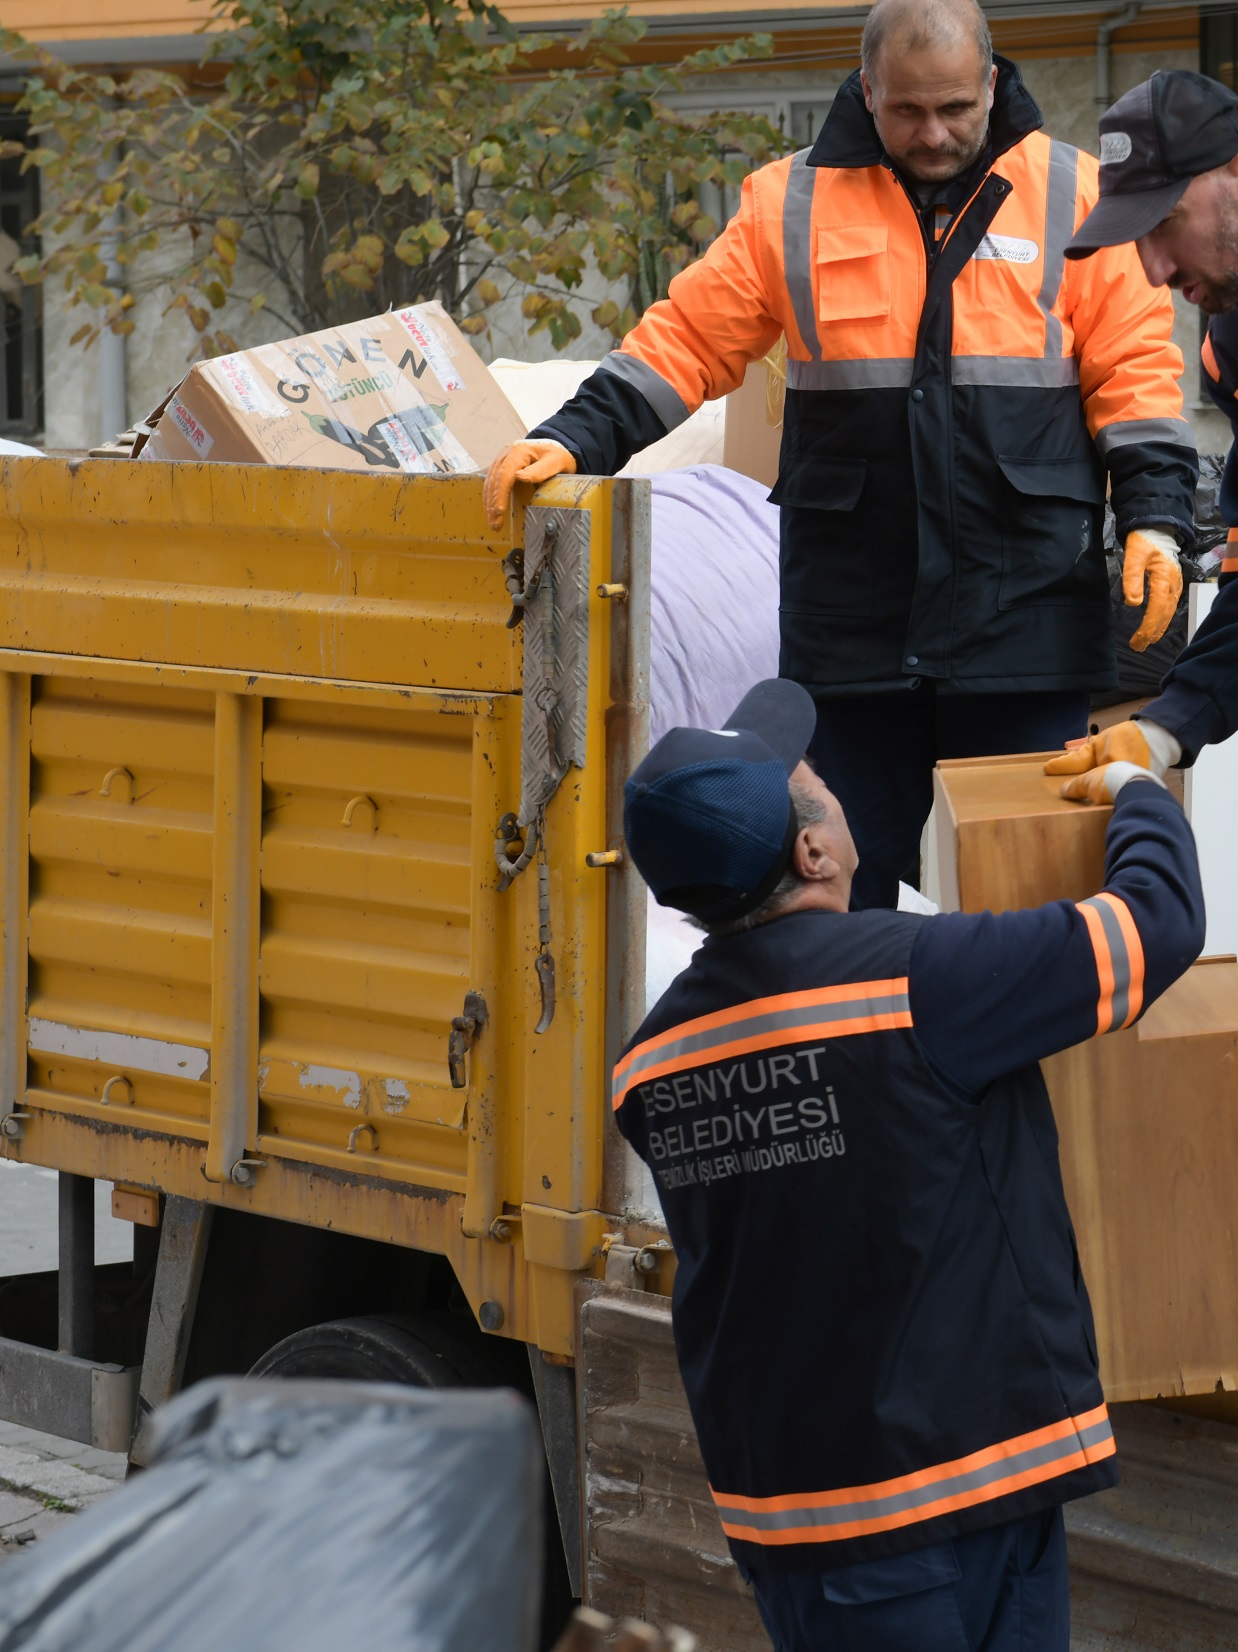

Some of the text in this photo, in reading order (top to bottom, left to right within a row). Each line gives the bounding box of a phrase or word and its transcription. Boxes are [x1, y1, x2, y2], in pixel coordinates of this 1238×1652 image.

[276, 337, 428, 404] GÖNEN
[638, 1047, 826, 1117] ESENYURT
[649, 1086, 841, 1161] BELEDİYESİ
[697, 1148, 742, 1187] İŞLERİ
